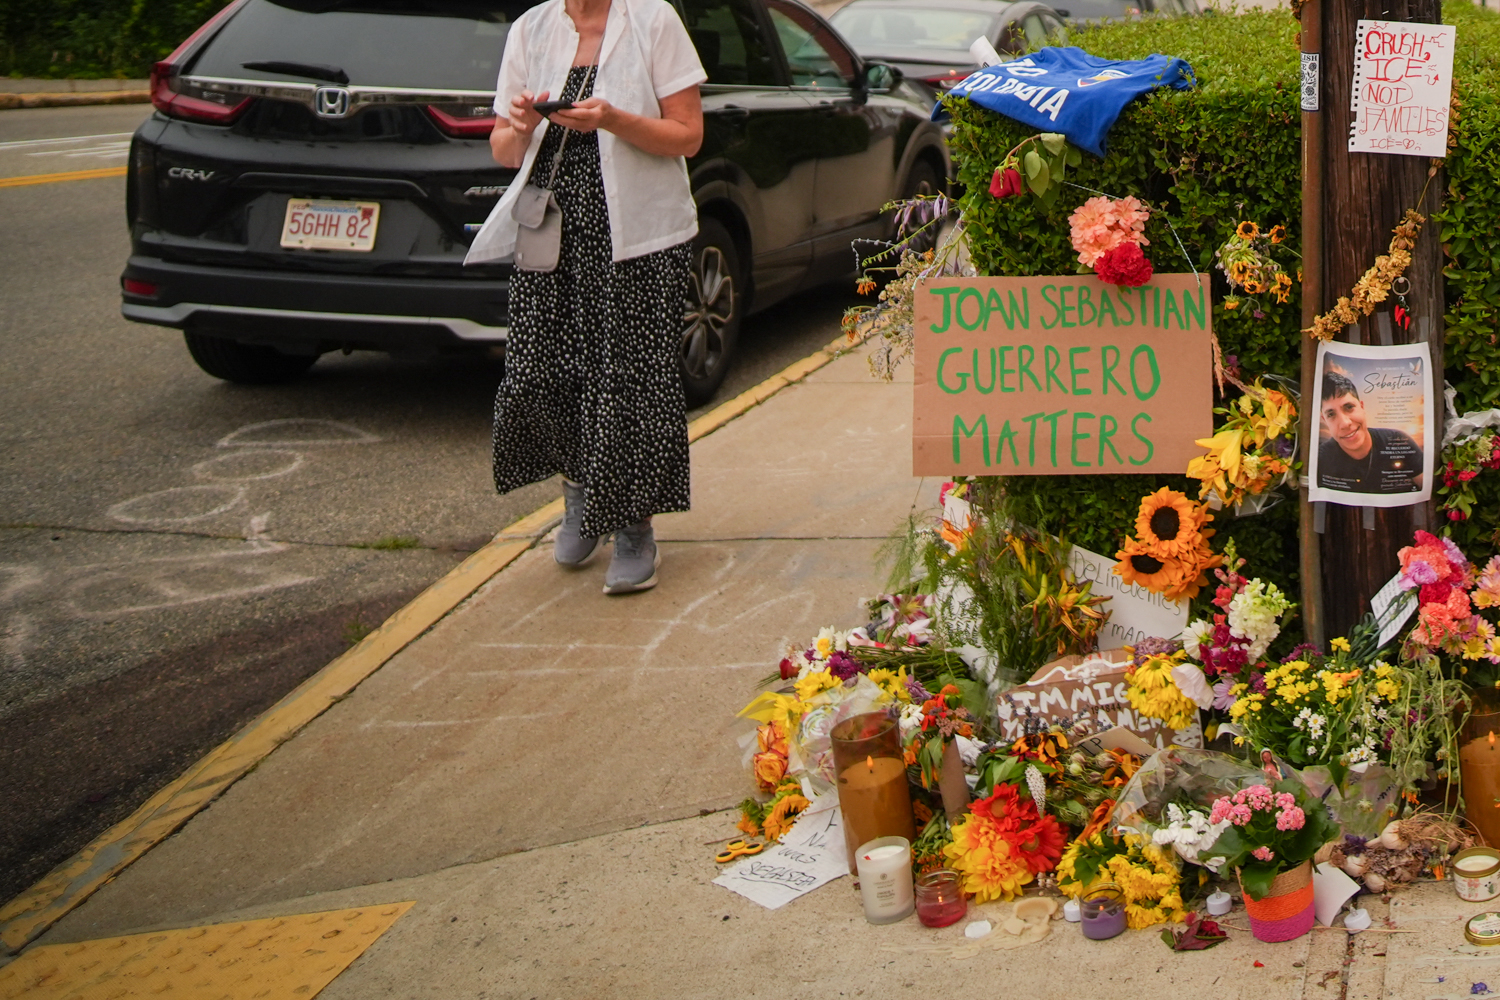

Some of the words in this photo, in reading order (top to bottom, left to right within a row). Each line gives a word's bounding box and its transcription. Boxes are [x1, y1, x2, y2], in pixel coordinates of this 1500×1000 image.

[1365, 30, 1425, 57] CRUSH
[1366, 56, 1427, 83] ICE
[1367, 83, 1407, 104] NOT
[168, 167, 215, 182] CR-V
[288, 212, 341, 236] 5GHH
[346, 215, 371, 238] 82
[929, 286, 1030, 334] JOAN
[1039, 284, 1206, 331] SEBASTIAN
[936, 343, 1162, 401] GUERRERO
[951, 408, 1155, 468] MATTERS
